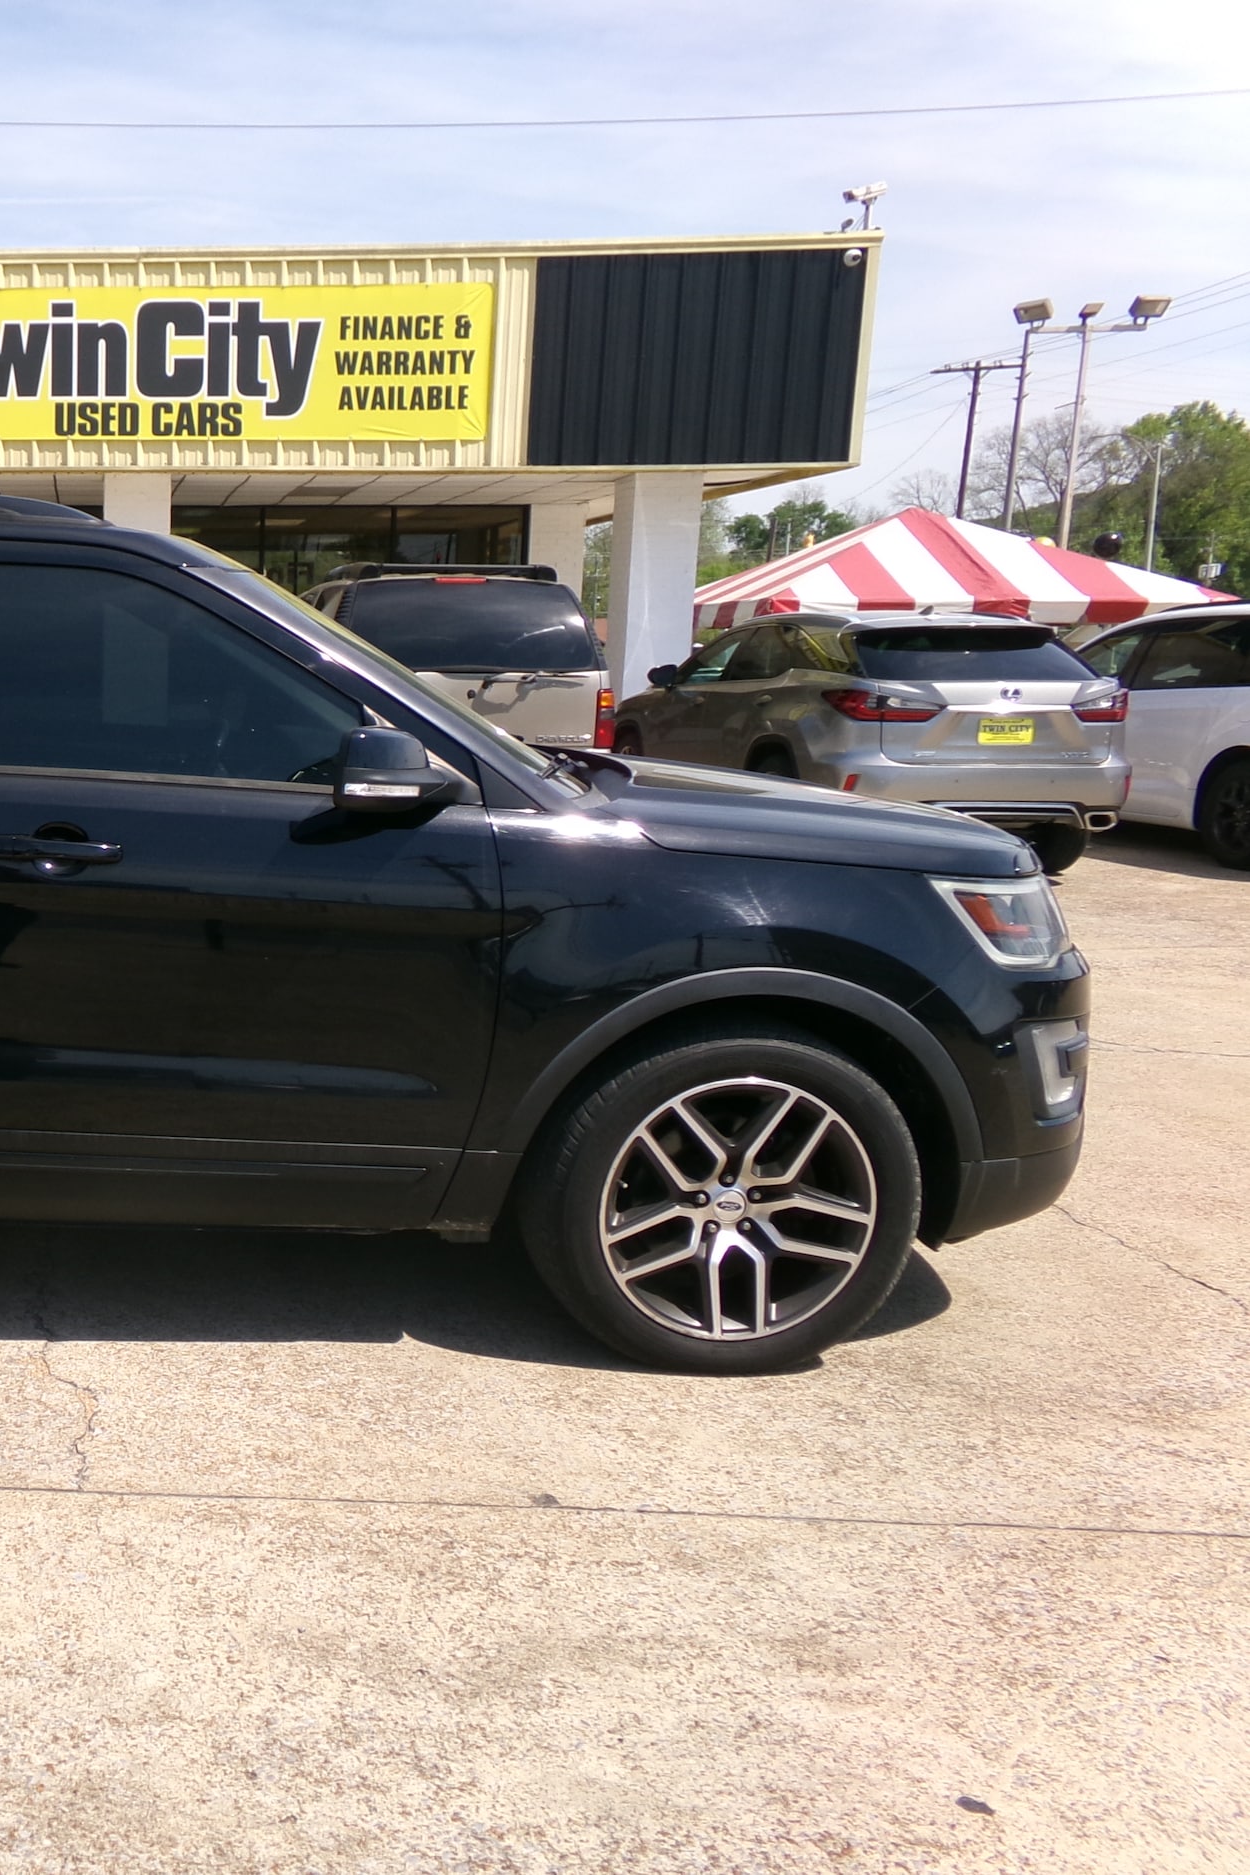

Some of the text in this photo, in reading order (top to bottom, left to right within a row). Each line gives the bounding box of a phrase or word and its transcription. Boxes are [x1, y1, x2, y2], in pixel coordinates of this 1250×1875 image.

[339, 315, 472, 341] FINANCE &
[335, 350, 475, 376] WARRANTY
[338, 385, 469, 411] AVAILABLE
[55, 402, 242, 437] USED CARS
